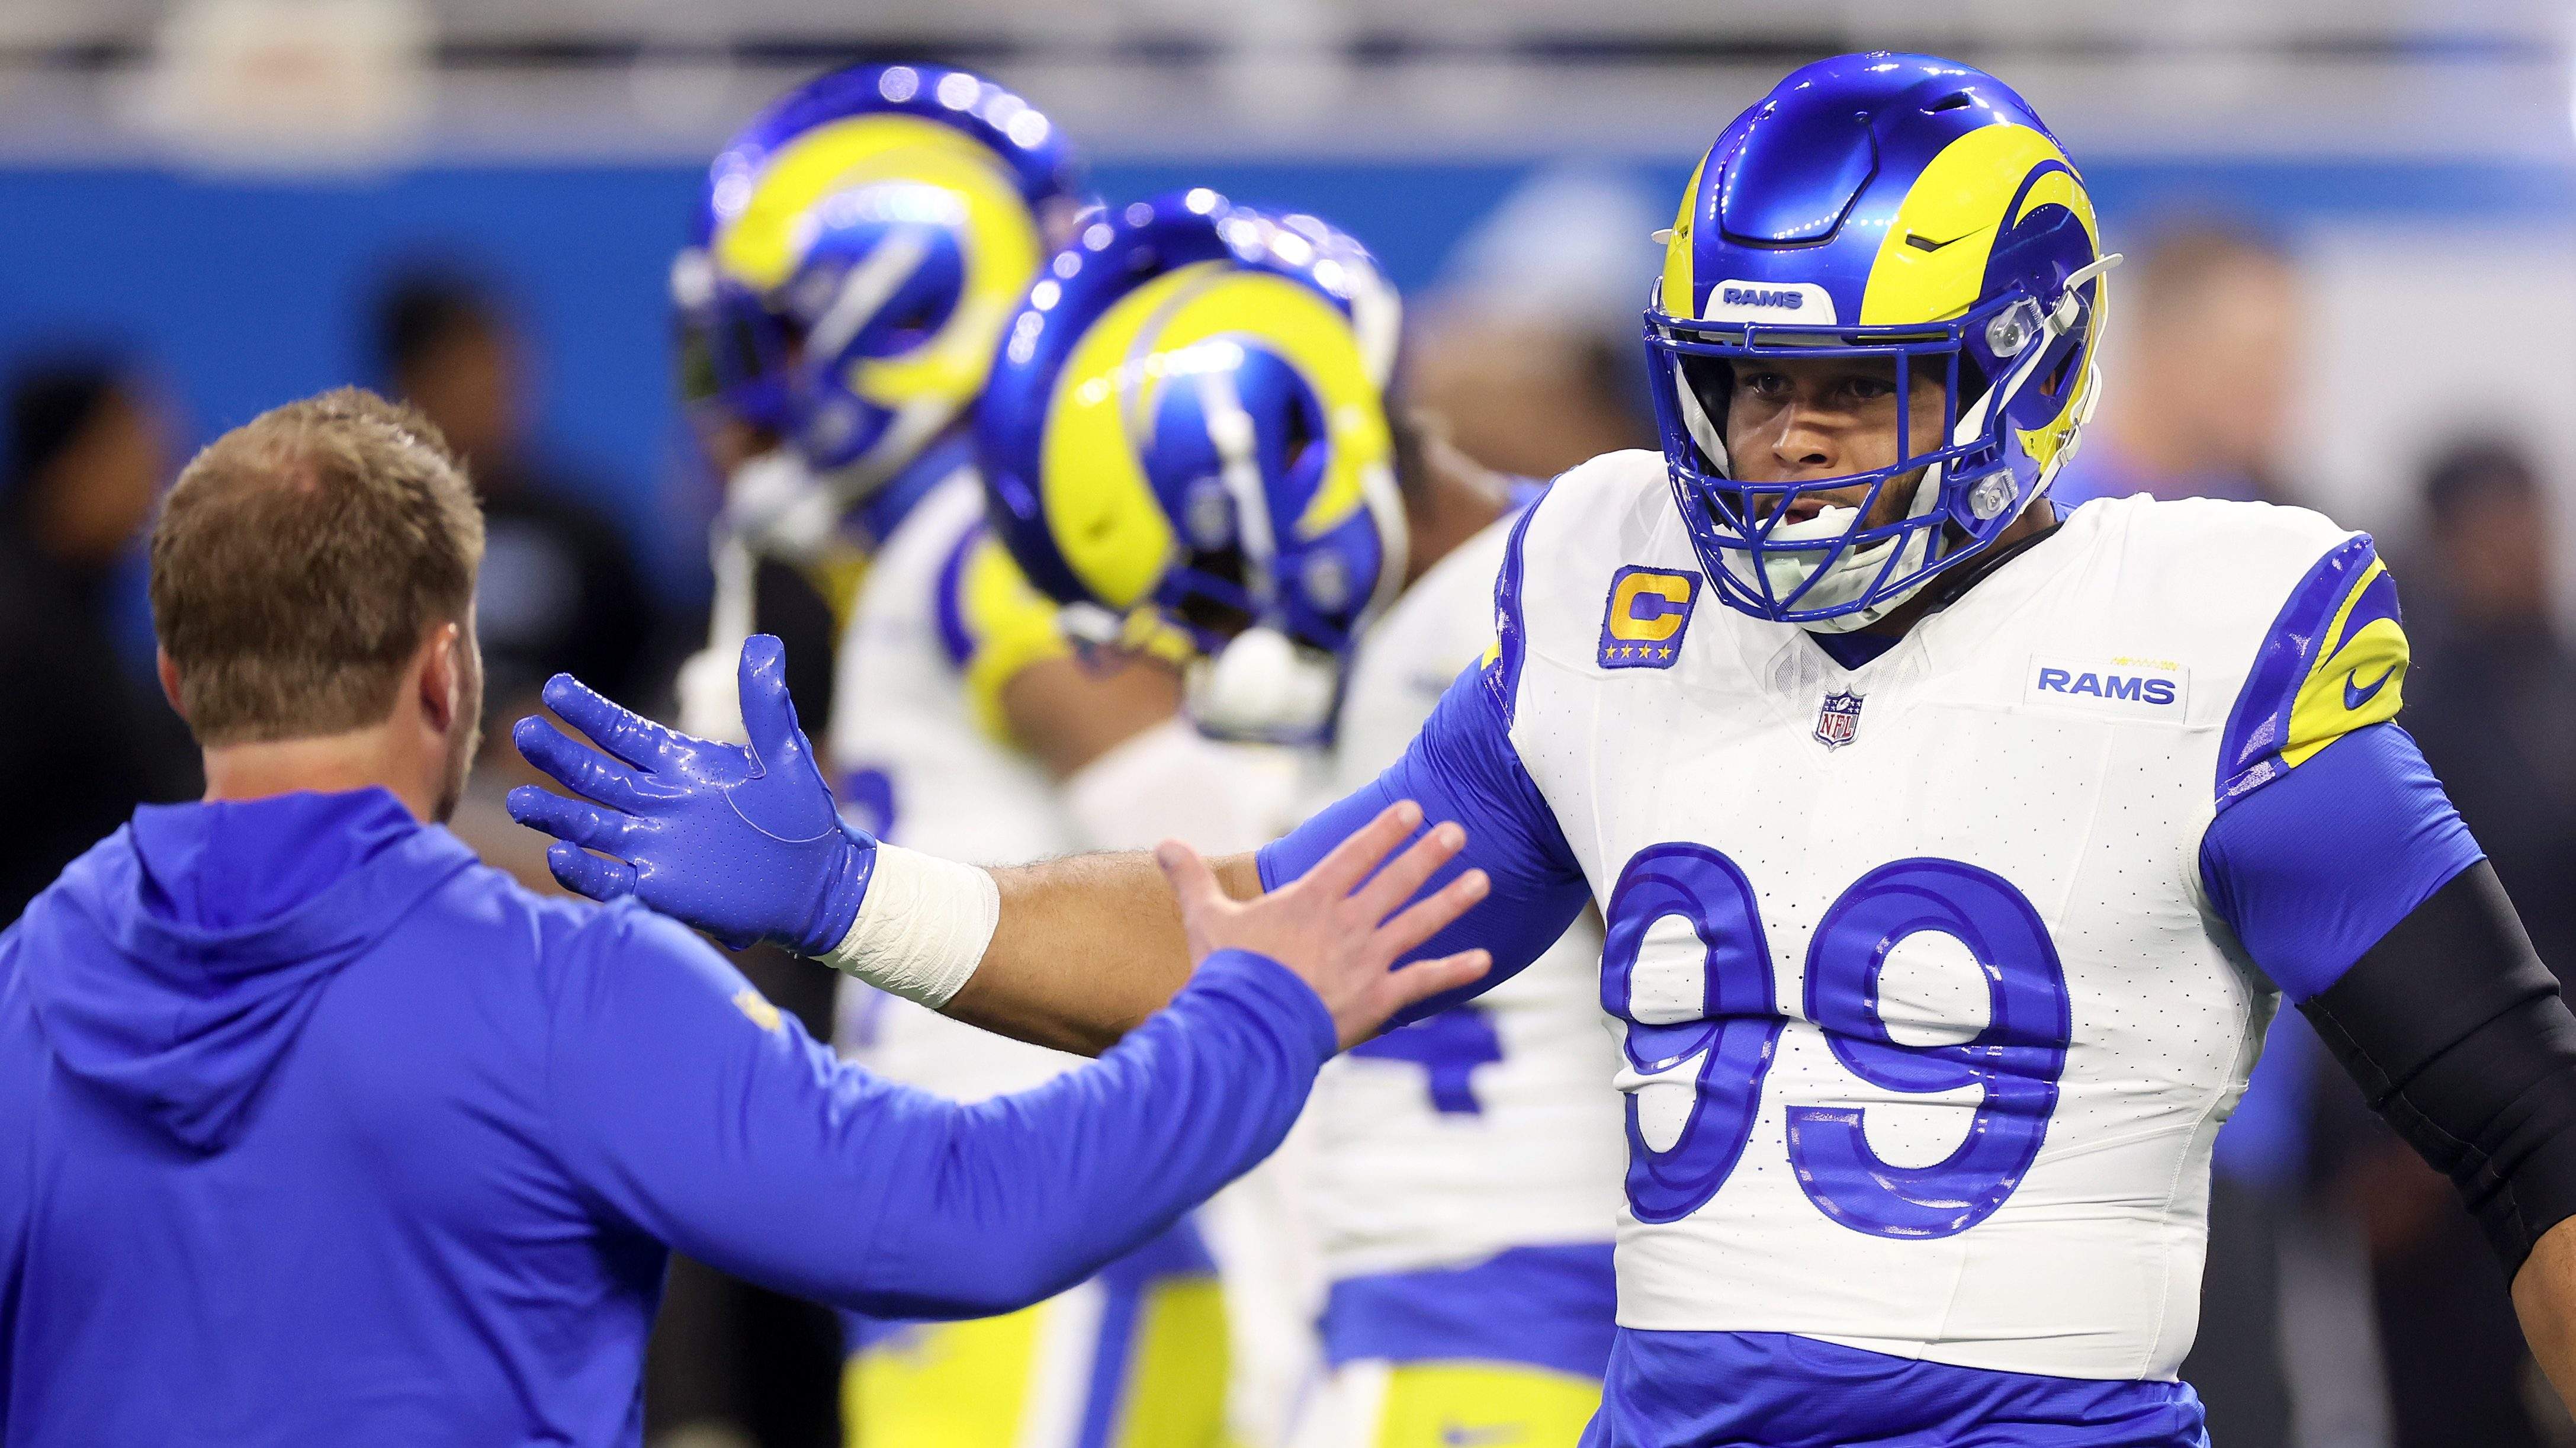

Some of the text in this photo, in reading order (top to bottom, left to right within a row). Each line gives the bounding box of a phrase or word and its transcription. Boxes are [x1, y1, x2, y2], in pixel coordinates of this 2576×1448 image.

[1723, 288, 1803, 310] RAMS
[1608, 572, 1691, 641] C
[2038, 667, 2176, 705] RAMS
[1820, 713, 1852, 740] NFL
[1600, 842, 2072, 1241] 99
